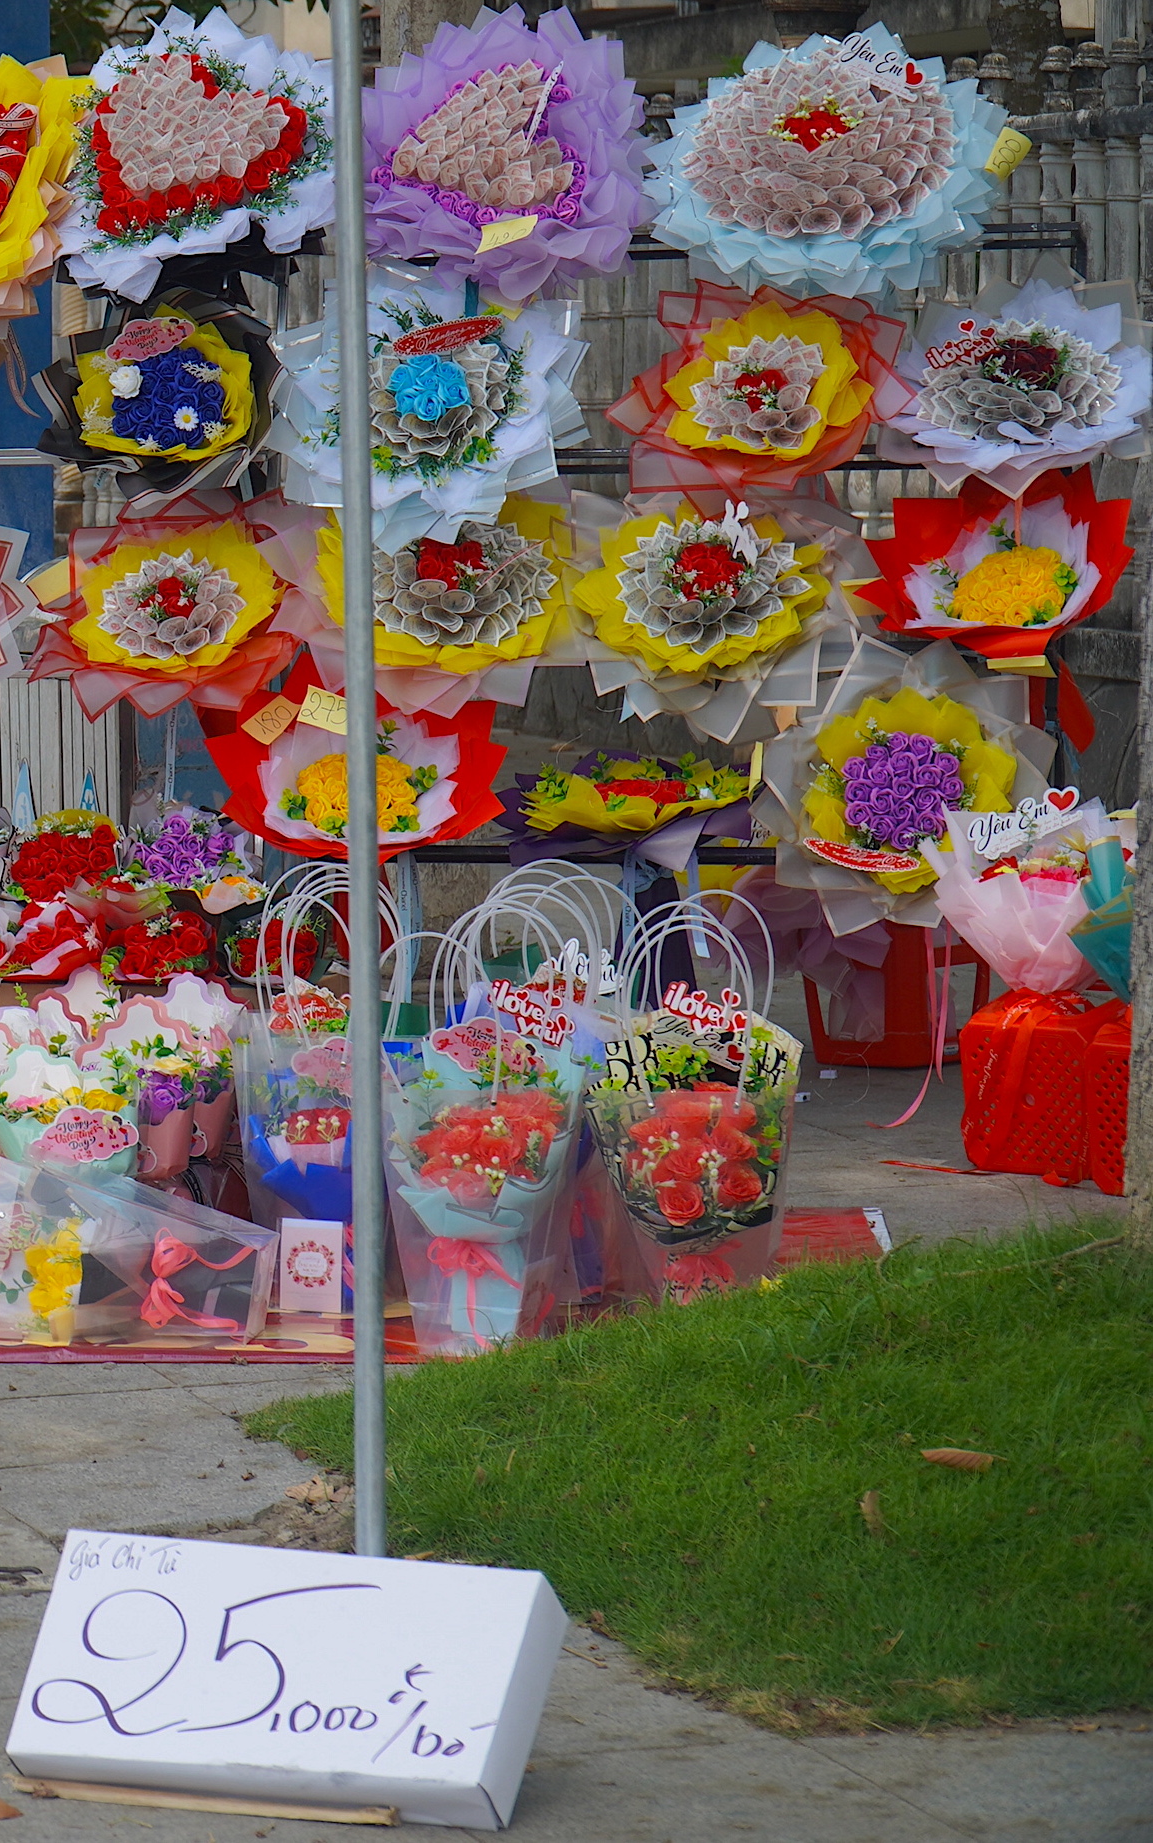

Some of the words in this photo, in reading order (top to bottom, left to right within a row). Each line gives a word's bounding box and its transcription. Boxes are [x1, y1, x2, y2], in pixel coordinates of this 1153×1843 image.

[840, 35, 876, 63] Yêu
[875, 51, 905, 77] Em
[992, 138, 1022, 178] 500
[253, 705, 293, 736] 180
[301, 691, 347, 725] 275
[969, 814, 1013, 852] Yêu
[1018, 799, 1050, 830] Em
[653, 1015, 693, 1038] Yêu
[693, 1031, 726, 1052] Em
[56, 1120, 93, 1134] Happy
[69, 1136, 96, 1151] Day
